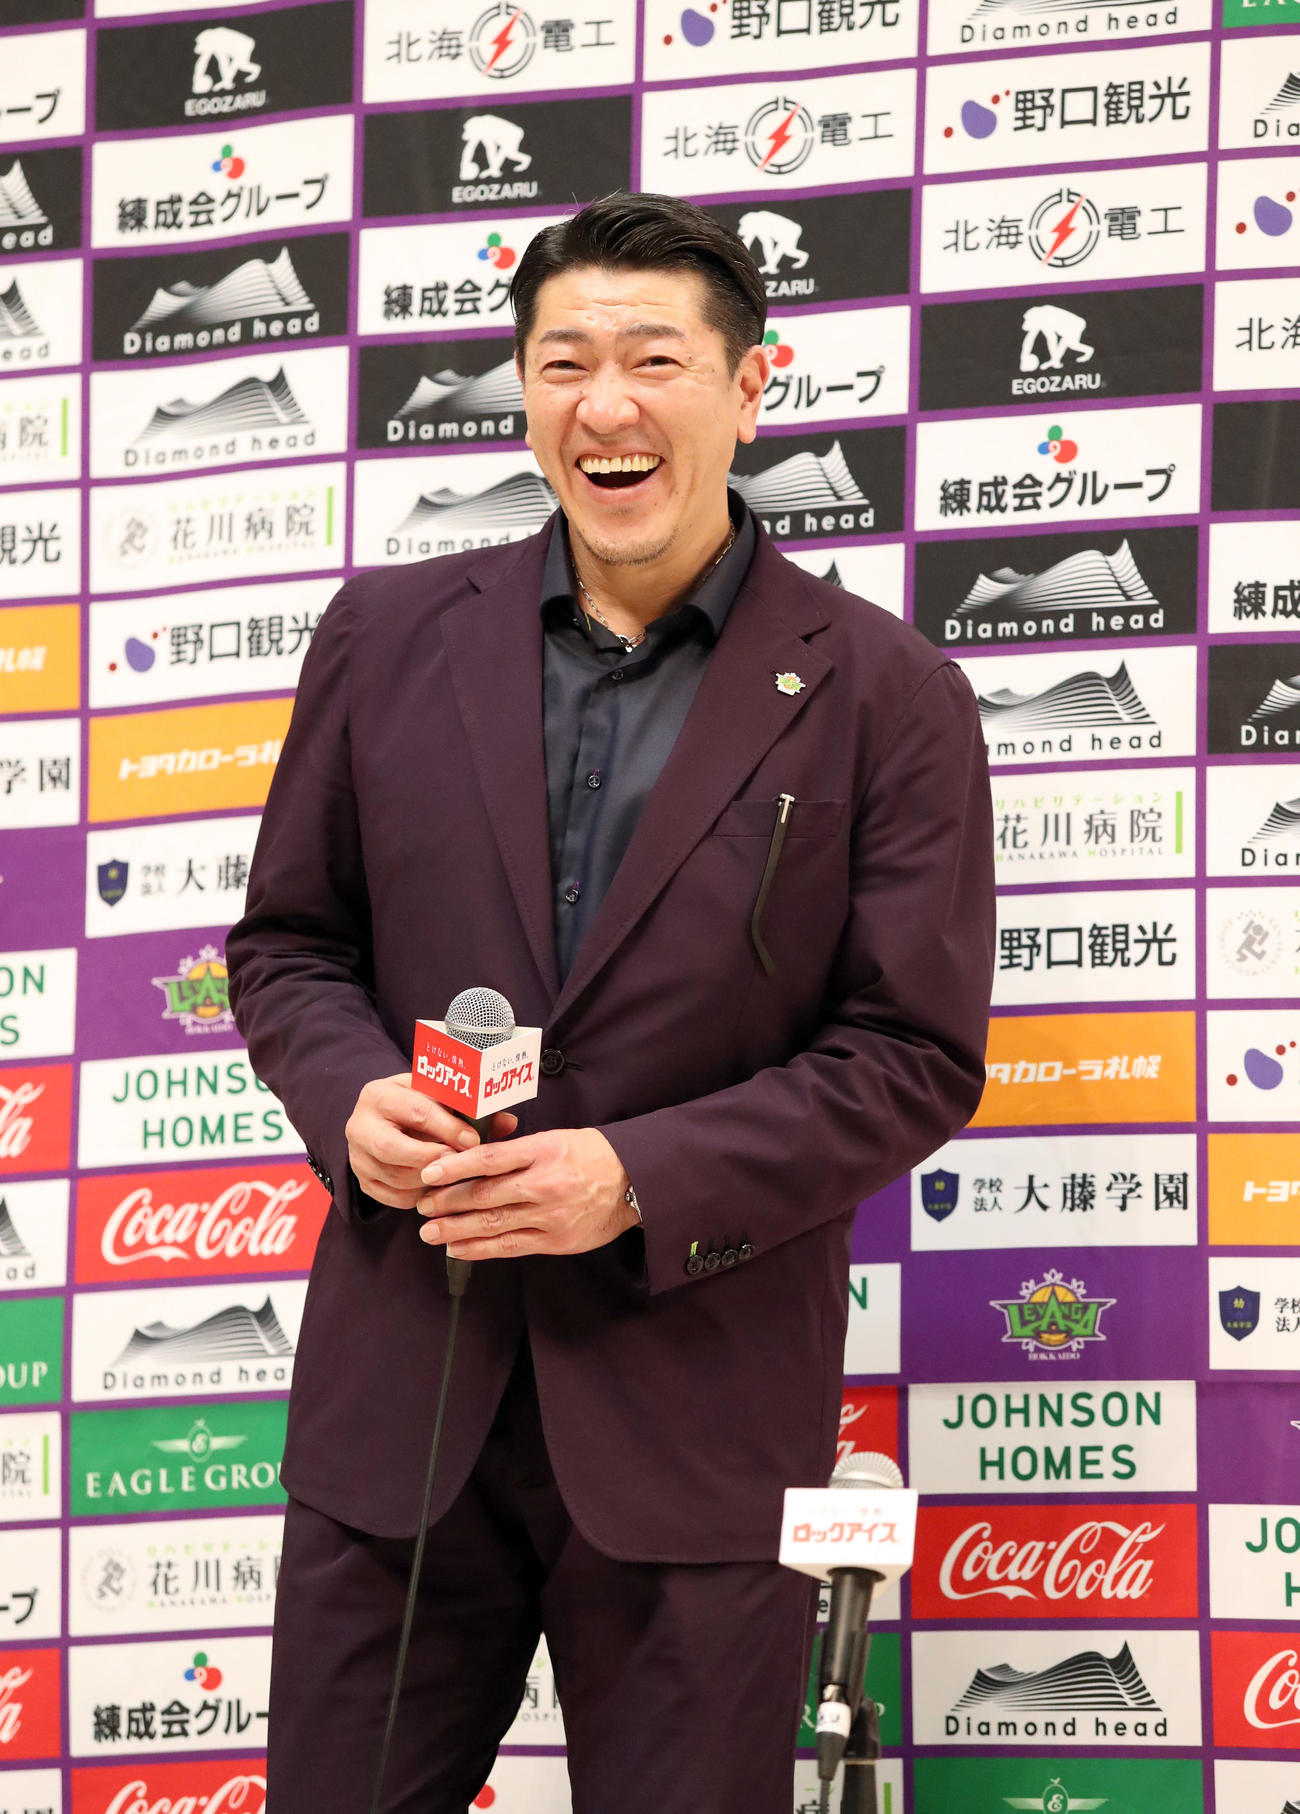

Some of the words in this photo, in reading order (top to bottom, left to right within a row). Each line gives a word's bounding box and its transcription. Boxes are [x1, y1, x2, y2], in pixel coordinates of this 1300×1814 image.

[730, 0, 899, 40] 野口観光
[961, 15, 1089, 44] Diamond
[1108, 7, 1178, 31] head
[184, 90, 266, 117] EGOZARU
[1013, 76, 1191, 132] 野口観光
[117, 173, 329, 234] 練成会グループ
[452, 181, 538, 203] EGOZARU
[1, 224, 53, 250] ead
[383, 277, 512, 321] 練成会グ
[764, 279, 815, 297] ZARU
[123, 321, 242, 354] Diamond
[252, 311, 320, 339] head
[1, 343, 50, 361] ead
[763, 364, 885, 411] グループ
[1012, 374, 1101, 395] EGOZARU
[387, 414, 514, 442] Diamond
[124, 440, 237, 467] Diamond
[252, 430, 316, 451] head
[939, 463, 1176, 517] 練成会グループ
[804, 507, 875, 531] head
[945, 612, 1075, 641] Diamond
[1092, 608, 1164, 632] head
[118, 738, 282, 781] トヨタカローラ札
[986, 734, 1072, 757] mond
[1092, 730, 1162, 751] head
[0, 757, 70, 795] 学園
[996, 808, 1164, 850] 花川病院
[178, 853, 248, 894] 大藤
[999, 921, 1177, 971] 野口観光
[112, 1063, 270, 1103] JOHNS
[417, 1055, 472, 1098] ロックアイス
[484, 1062, 534, 1099] ロックアイス
[986, 1055, 1162, 1085] タカローラ札幌
[143, 1110, 284, 1149] HOMES
[1014, 1171, 1189, 1214] 大藤学園
[101, 1179, 311, 1266] Coca-Cola
[6, 1263, 36, 1281] ad
[103, 1367, 222, 1391] Diamond
[238, 1365, 285, 1383] hea
[942, 1390, 1163, 1429] JOHNSON
[86, 1466, 197, 1498] EAGLE
[204, 1462, 281, 1491] GRO
[979, 1444, 1137, 1481] HOMES
[793, 1522, 898, 1544] ロックアイス
[150, 1555, 281, 1596] 花川病
[938, 1521, 1166, 1601] Coca-Cola
[92, 1698, 268, 1743] 練成会グル
[945, 1715, 1077, 1738] Diamond
[1095, 1717, 1168, 1738] head
